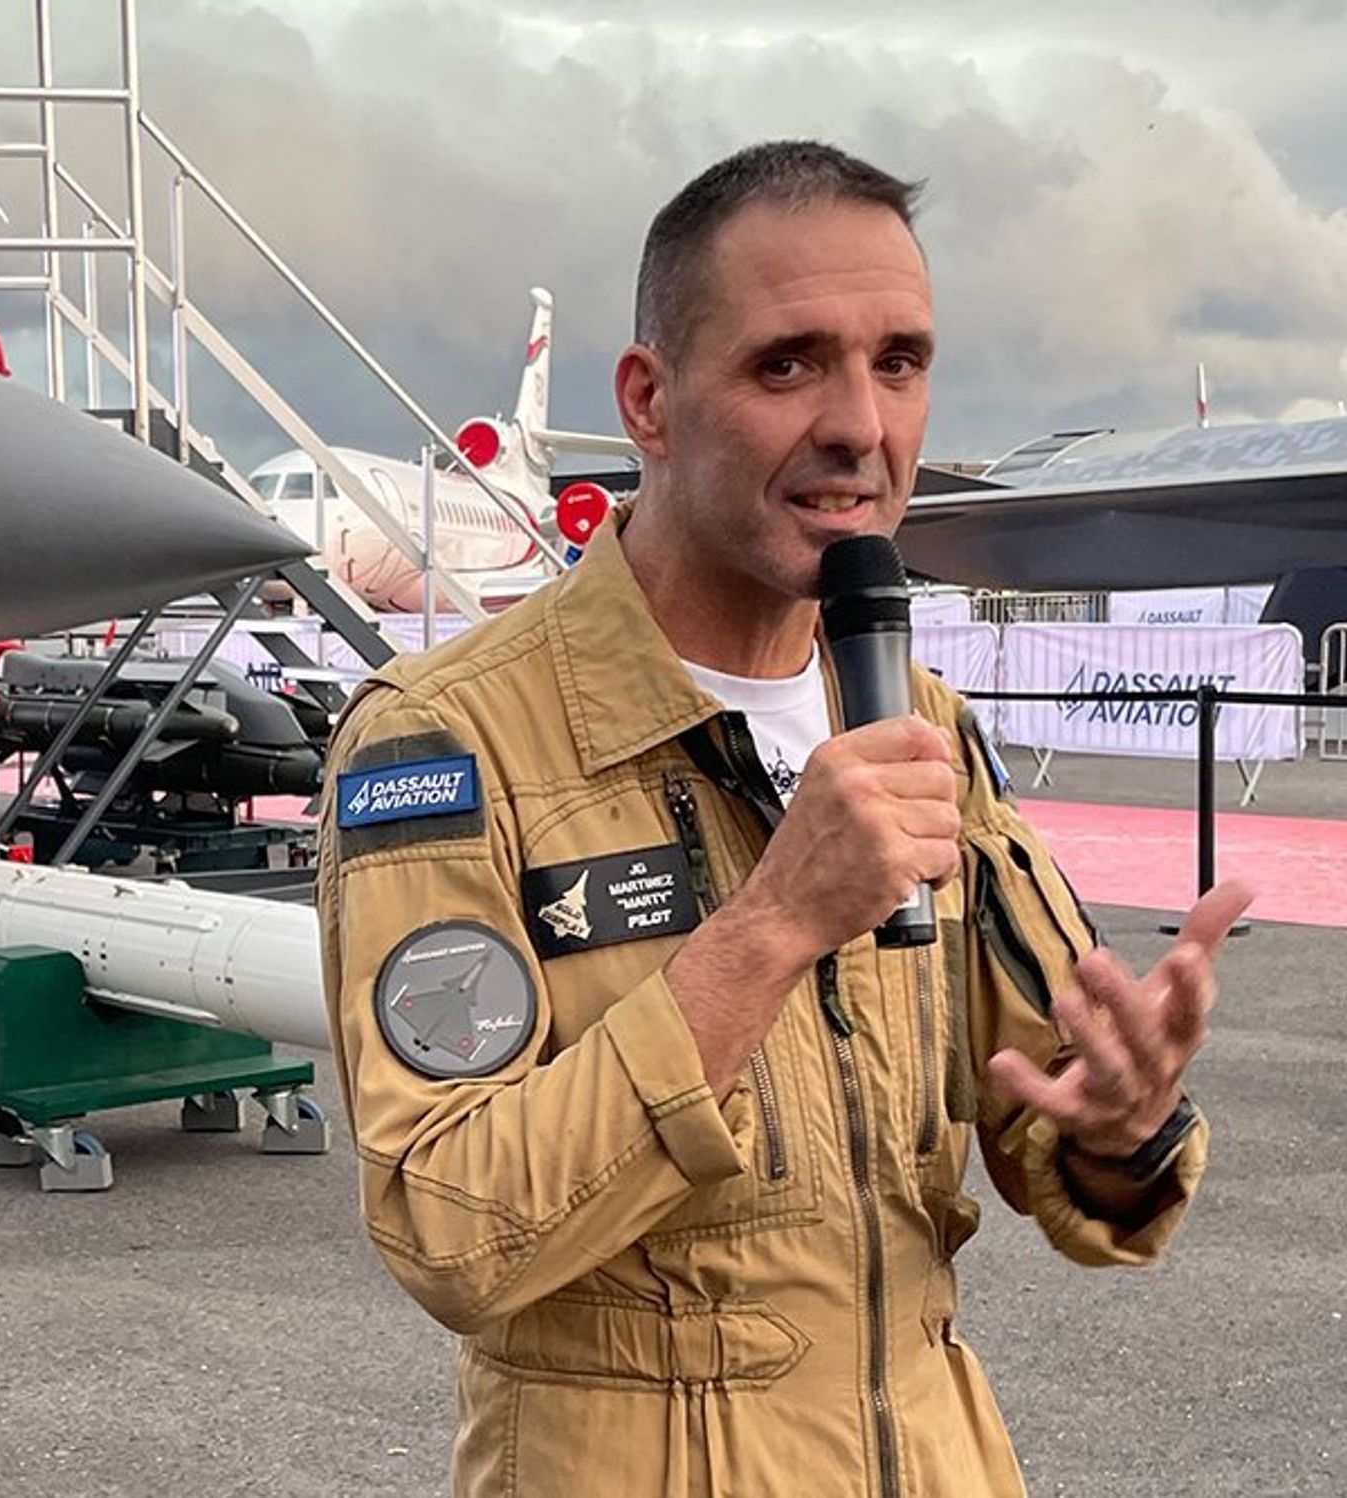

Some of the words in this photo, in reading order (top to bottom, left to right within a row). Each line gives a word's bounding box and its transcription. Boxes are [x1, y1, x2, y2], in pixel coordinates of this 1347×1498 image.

[1147, 608, 1203, 623] DASSAULT
[371, 772, 465, 797] DASSAULT
[370, 788, 457, 812] AVIATION
[608, 873, 675, 896] MARTINEZ
[617, 890, 673, 910] "MARTY"
[627, 909, 673, 929] PILOT
